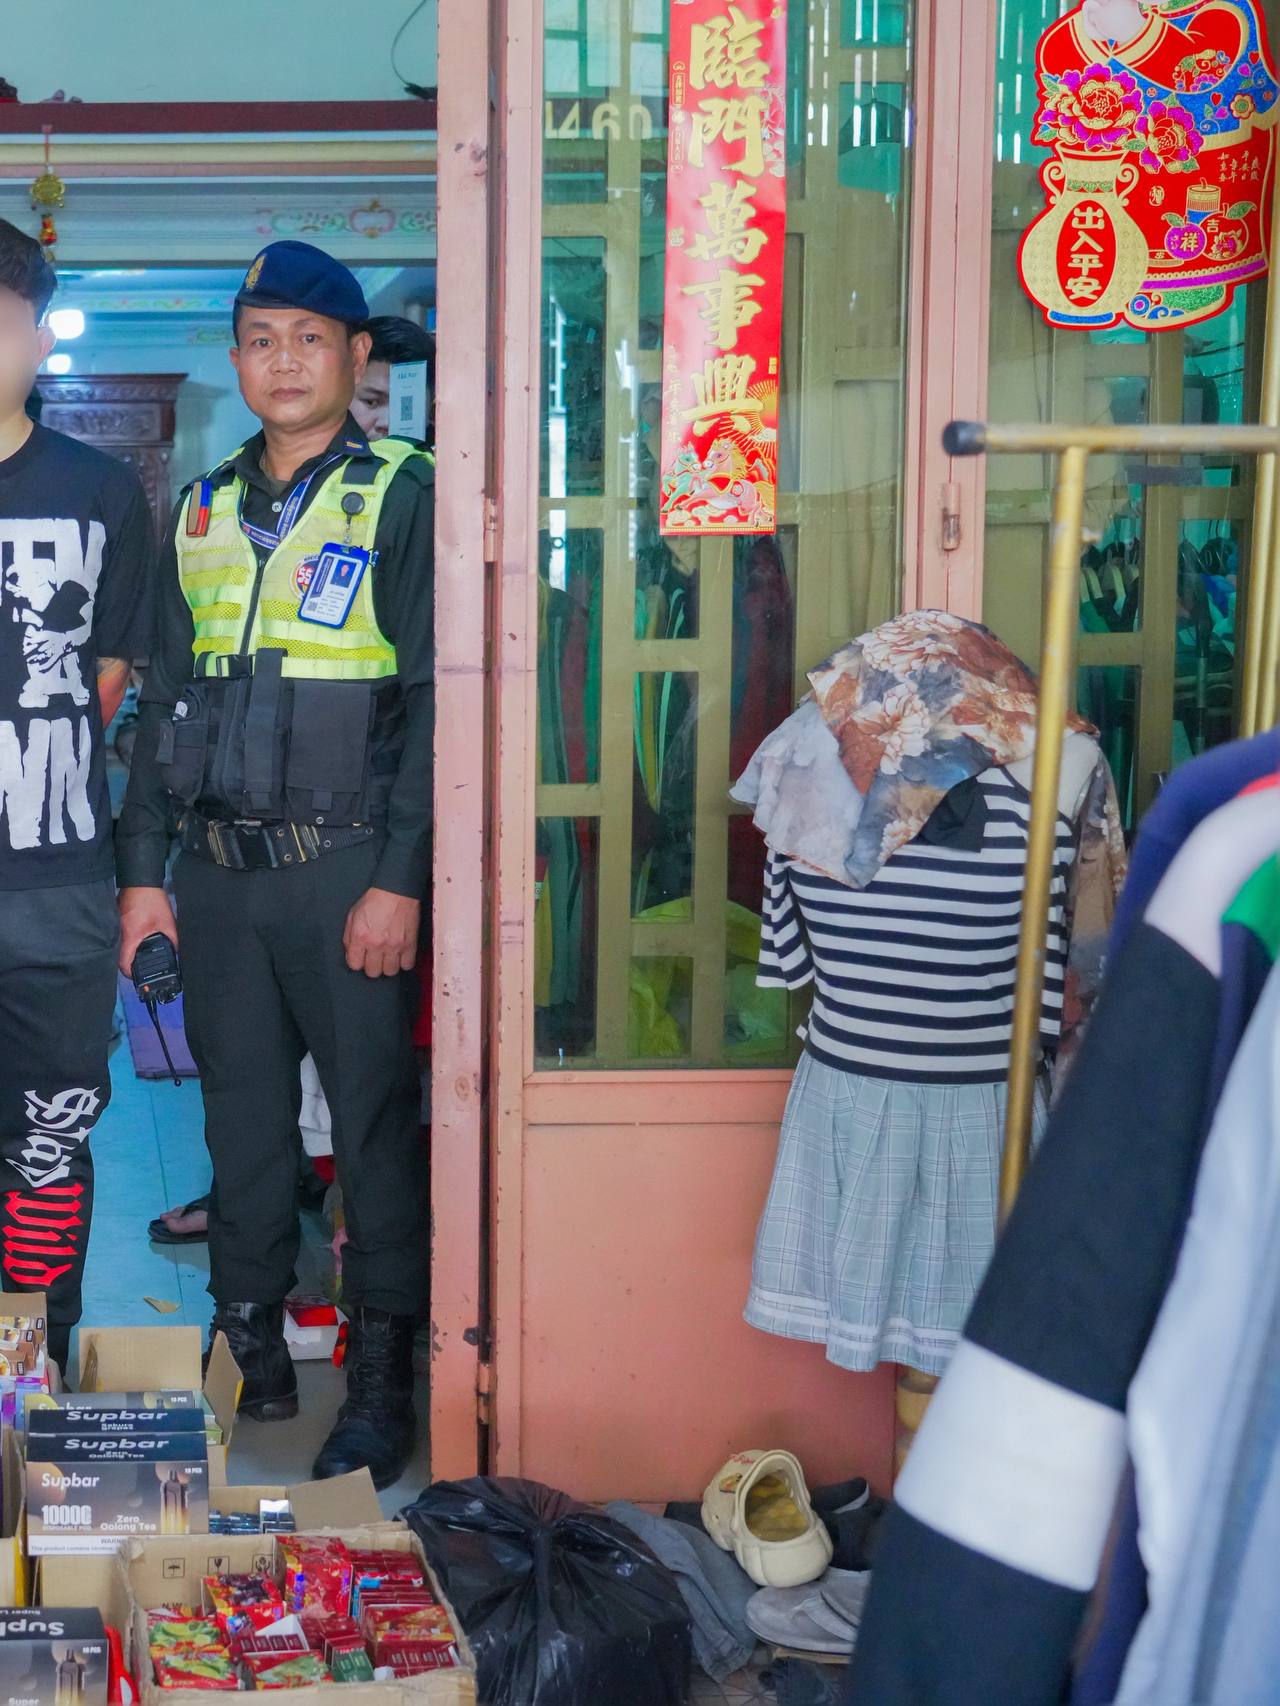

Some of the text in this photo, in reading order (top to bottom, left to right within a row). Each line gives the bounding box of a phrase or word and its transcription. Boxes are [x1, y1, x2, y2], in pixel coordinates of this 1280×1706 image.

[1065, 206, 1104, 300] 出入平安
[66, 1410, 168, 1422] Supbar
[64, 1438, 170, 1451] Supbar
[41, 1472, 100, 1490] Supbar
[41, 1504, 92, 1525] 10000
[116, 1515, 140, 1523] Zero
[100, 1522, 157, 1531] Oolong Tea
